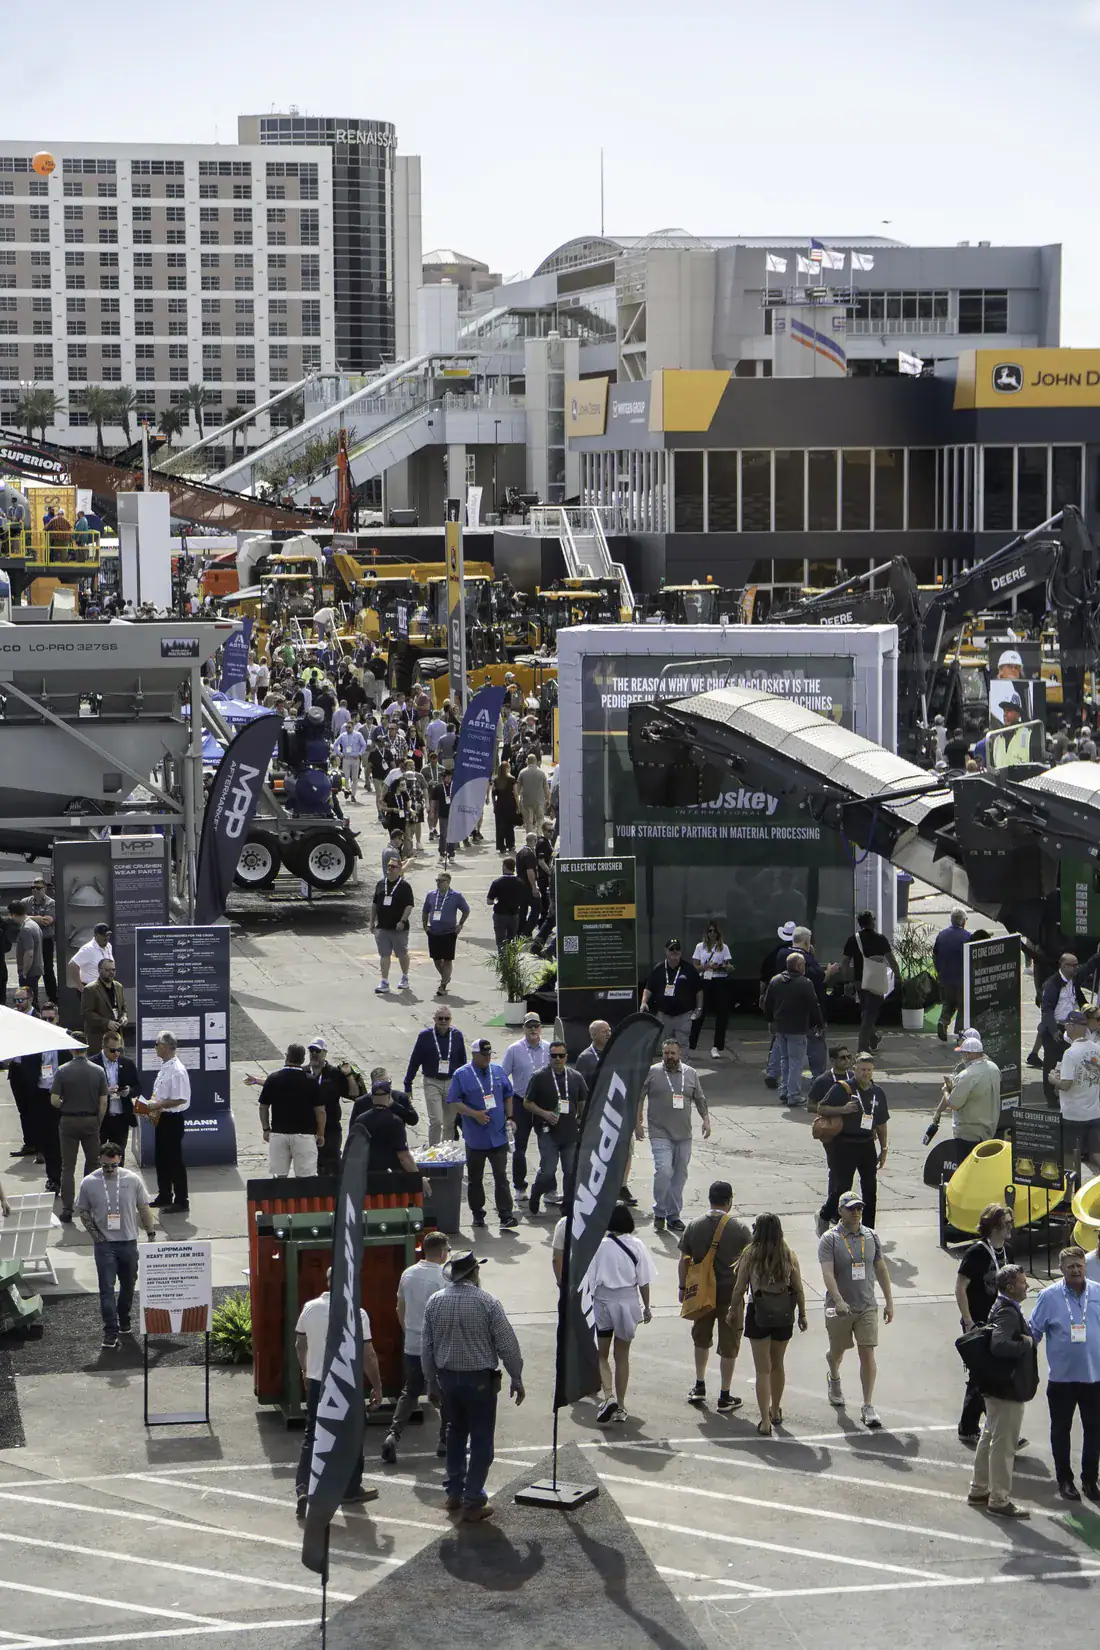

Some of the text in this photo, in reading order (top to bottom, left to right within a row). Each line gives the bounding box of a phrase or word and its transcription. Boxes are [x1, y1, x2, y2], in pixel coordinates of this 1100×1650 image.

[336, 128, 398, 149] RENAISSAN
[1031, 370, 1082, 386] JOHN
[0, 448, 62, 472] SUPERIOR
[991, 566, 1027, 591] DEERE
[820, 612, 853, 626] DEERE
[29, 644, 75, 652] LO-PRO
[77, 643, 118, 651] 327SS
[612, 678, 629, 692] THE
[631, 678, 666, 692] REASON
[668, 678, 689, 692] WHY
[691, 678, 704, 692] WE
[792, 679, 801, 693] IS
[803, 679, 821, 693] THE
[467, 719, 497, 731] ASTEC
[212, 760, 237, 832] AFTERMARKET
[224, 763, 260, 838] MPP
[686, 787, 779, 815] oskey
[615, 824, 820, 841] YOUR STRATEGIC PARTNER IN MATERIAL PROCESSING
[120, 841, 154, 852] MPP
[571, 862, 597, 872] ELECTRIC
[597, 861, 623, 871] CRUSHER
[1012, 1110, 1060, 1124] CONE CRUSHER LINERS
[572, 1071, 627, 1345] LIPPM
[308, 1193, 356, 1496] LIPPMAN
